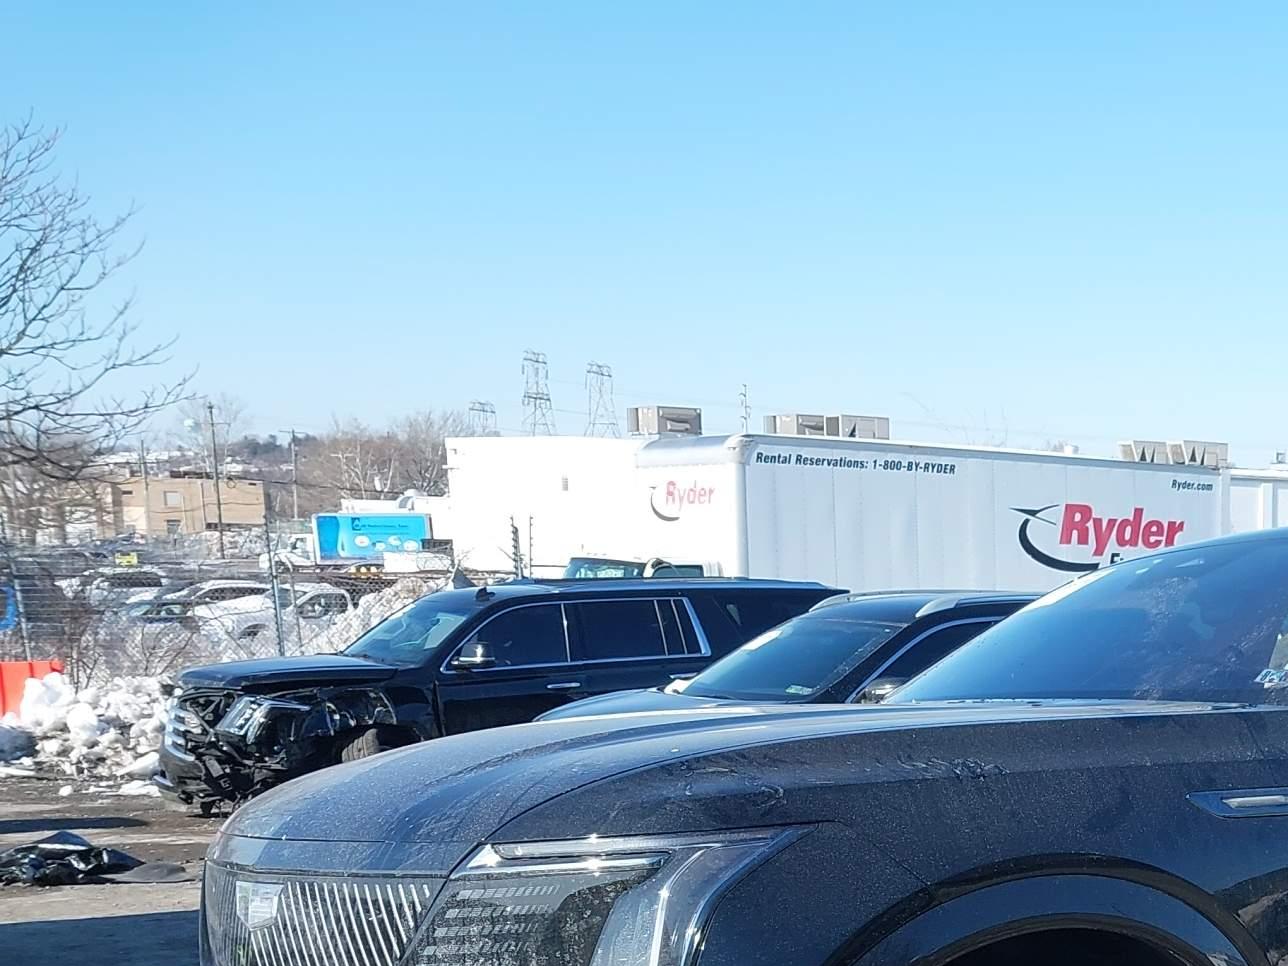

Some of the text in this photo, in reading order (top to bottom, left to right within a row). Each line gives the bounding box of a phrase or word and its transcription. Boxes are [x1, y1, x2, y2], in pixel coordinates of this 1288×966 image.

[755, 451, 956, 475] Rental Reservations: 1-800-BY-RYDER
[665, 480, 716, 512] Ryder
[1171, 479, 1213, 492] Ryder.com
[1059, 503, 1185, 557] Ryder
